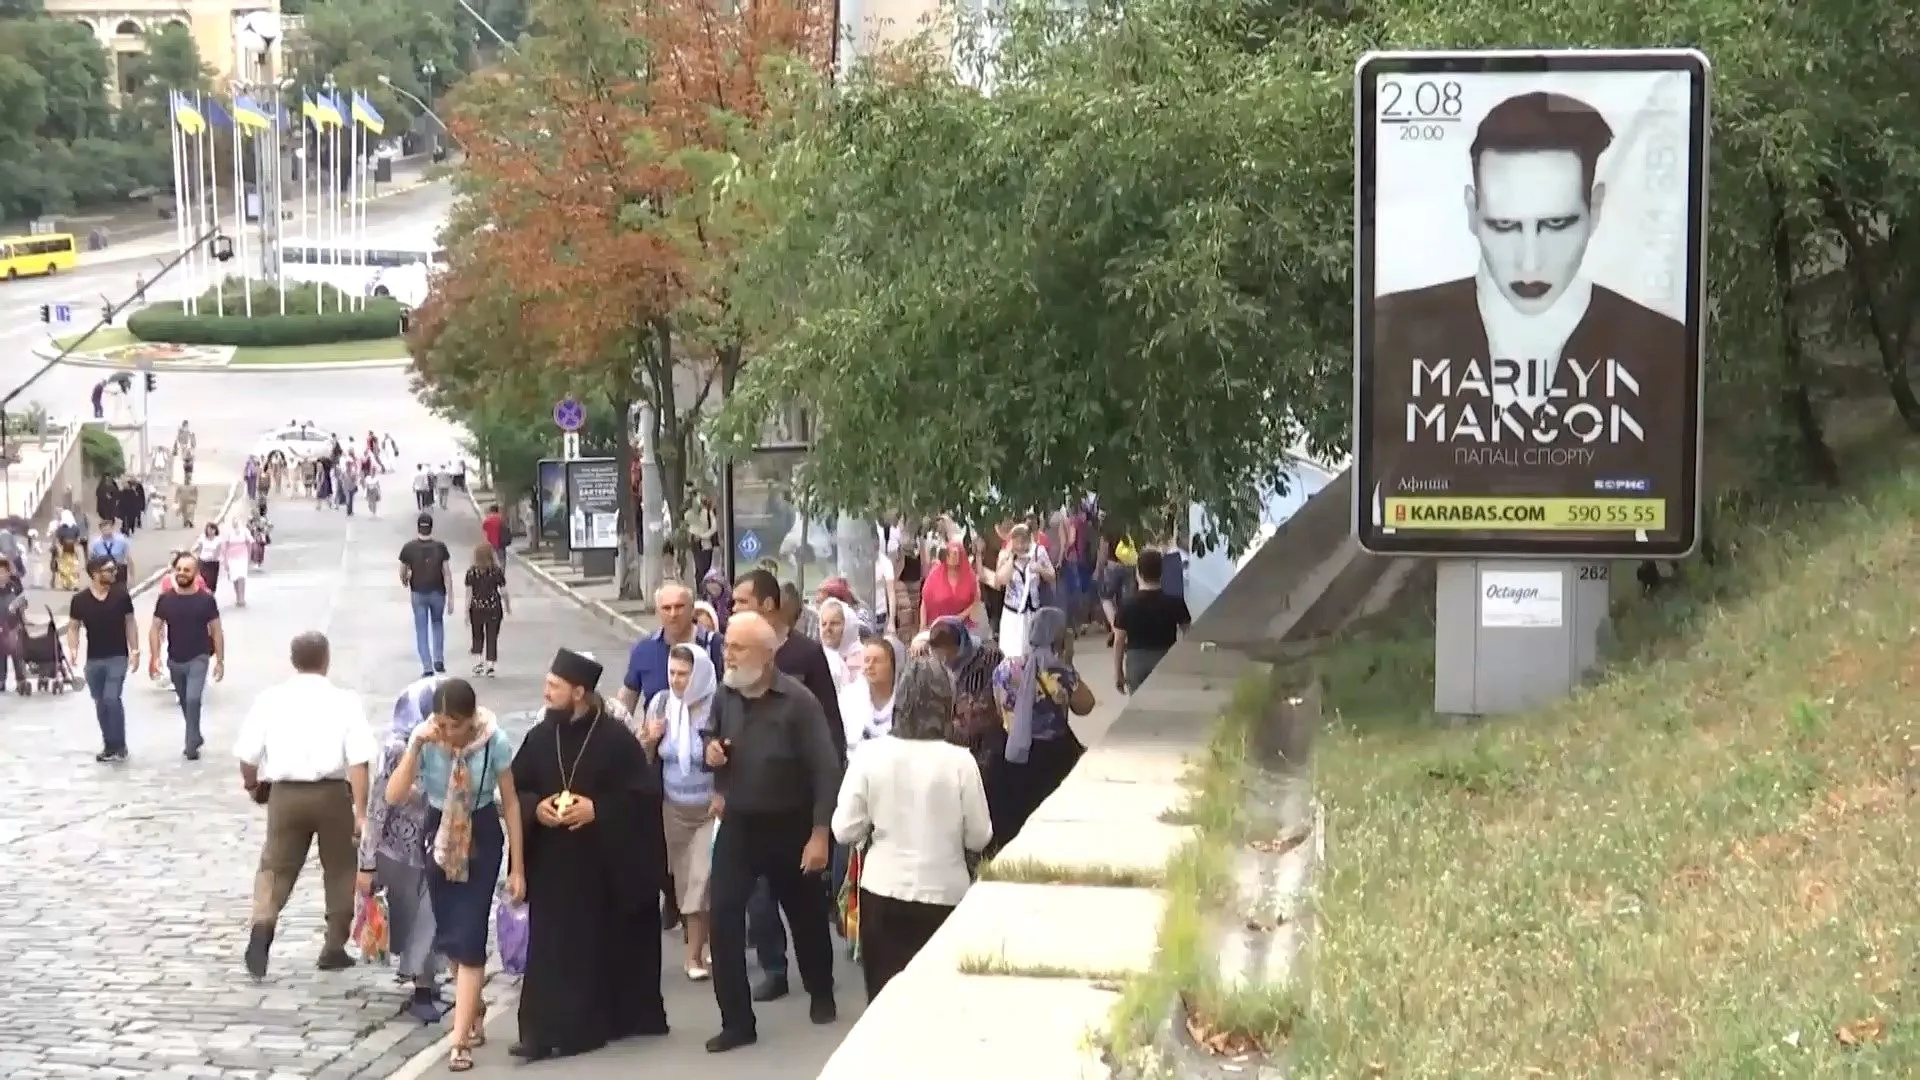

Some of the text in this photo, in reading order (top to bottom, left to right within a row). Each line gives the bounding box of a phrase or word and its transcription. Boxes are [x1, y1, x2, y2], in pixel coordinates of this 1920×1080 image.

[1381, 81, 1462, 116] 2.08
[1411, 357, 1641, 399] MARILYN
[1405, 402, 1645, 444] MANSON
[1454, 447, 1596, 467] ПАЛАЦ СПОРТУ
[1398, 475, 1450, 492] Афиша
[1411, 504, 1655, 521] KARABAS.COM 590 55 55
[1579, 565, 1608, 581] 262
[1486, 584, 1539, 604] Octagon
